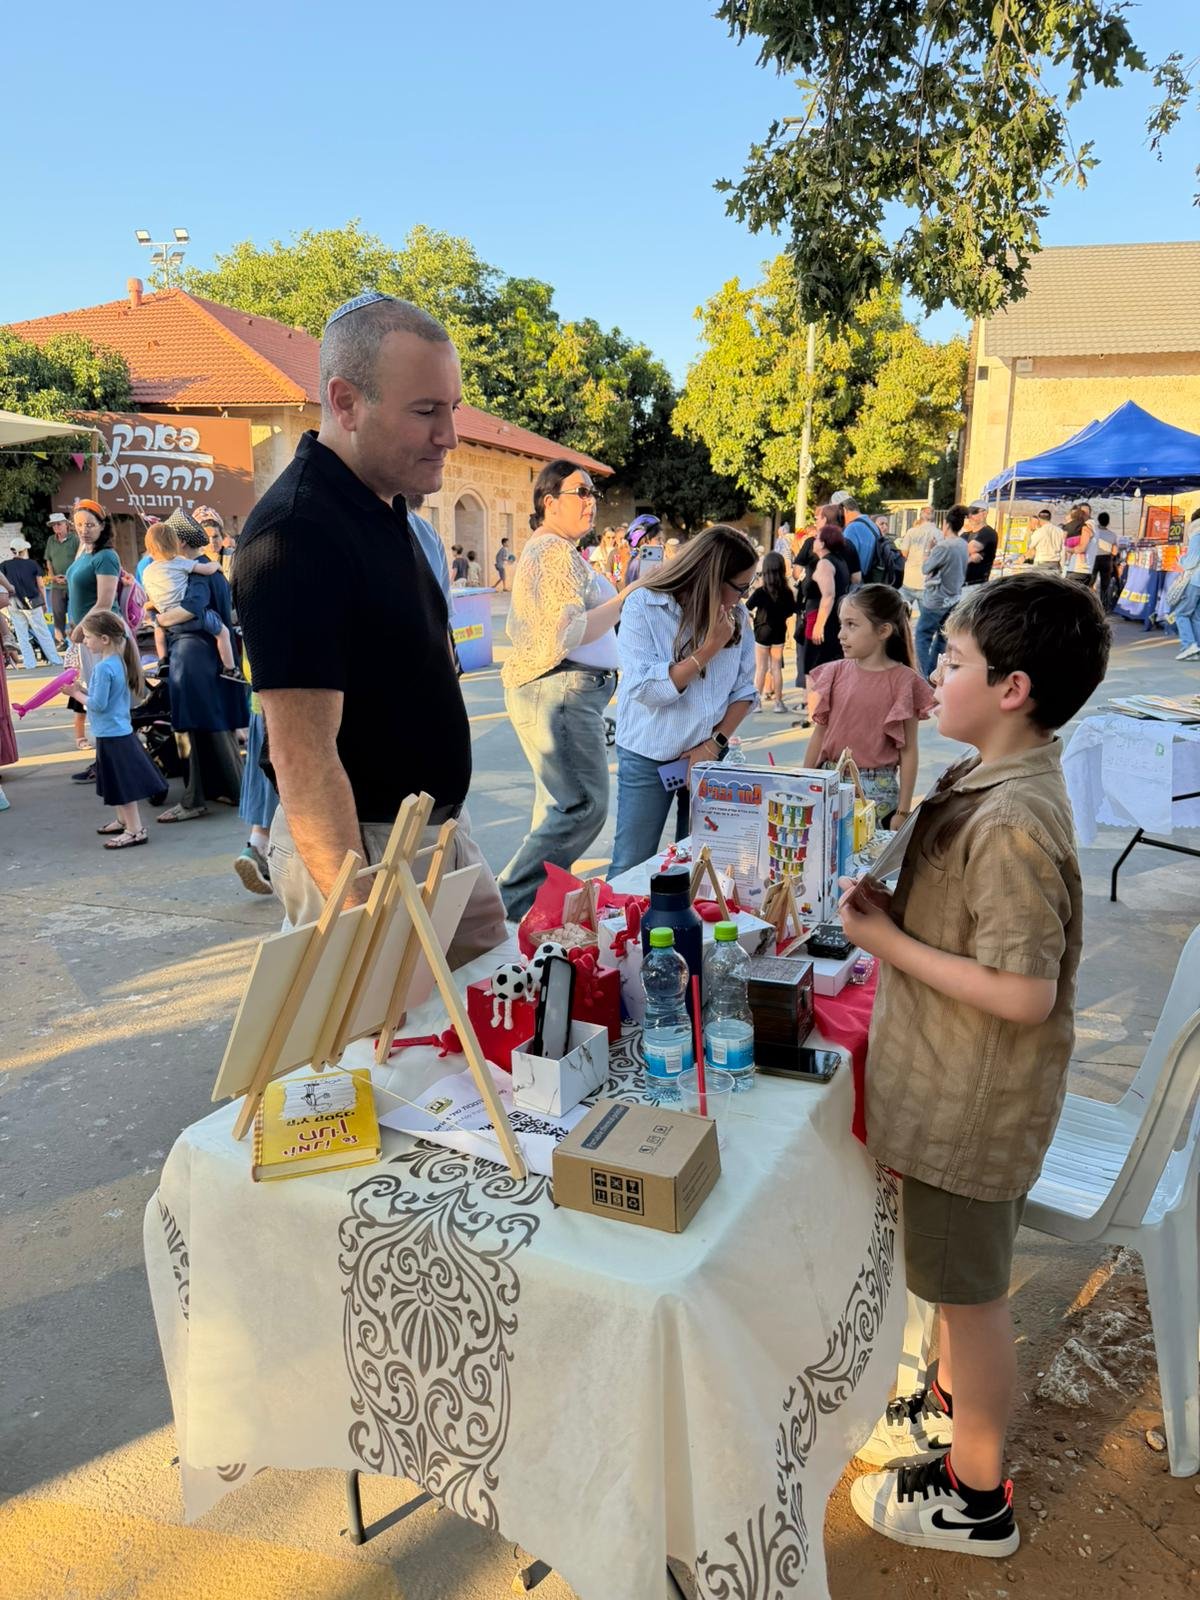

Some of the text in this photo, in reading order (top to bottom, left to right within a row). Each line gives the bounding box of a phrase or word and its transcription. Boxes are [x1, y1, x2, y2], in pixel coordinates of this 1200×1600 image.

[107, 424, 200, 465] פארק
[97, 463, 214, 492] ההדרים
[128, 494, 183, 508] רחובות
[299, 1119, 348, 1140] חנון
[283, 1140, 330, 1156] יומנו
